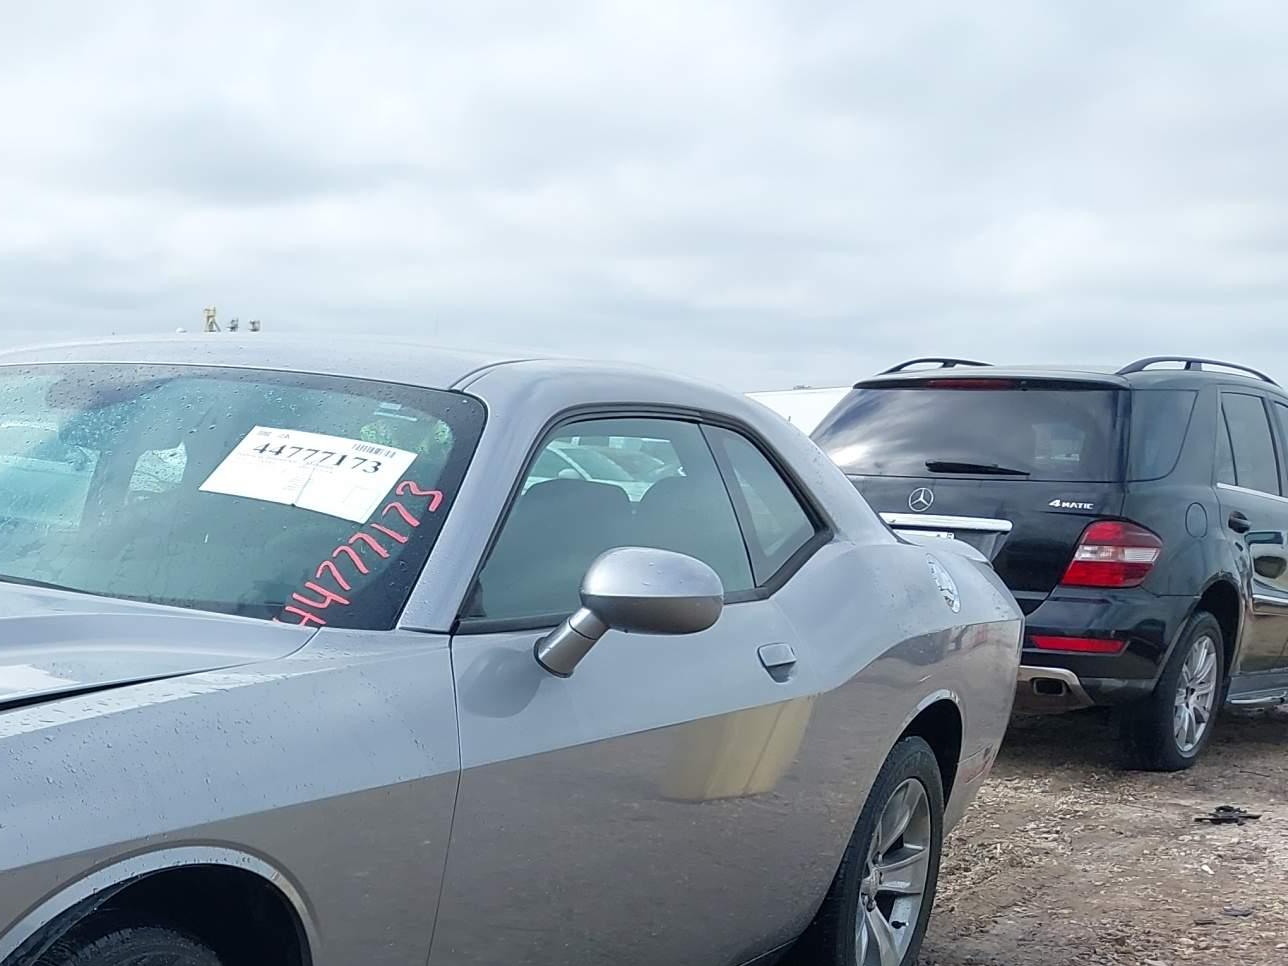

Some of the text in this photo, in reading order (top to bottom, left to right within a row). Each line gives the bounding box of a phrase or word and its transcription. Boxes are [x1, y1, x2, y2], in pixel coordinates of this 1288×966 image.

[253, 442, 382, 474] 44777173
[1048, 499, 1095, 510] 4MATIC
[272, 480, 444, 627] 44777173
